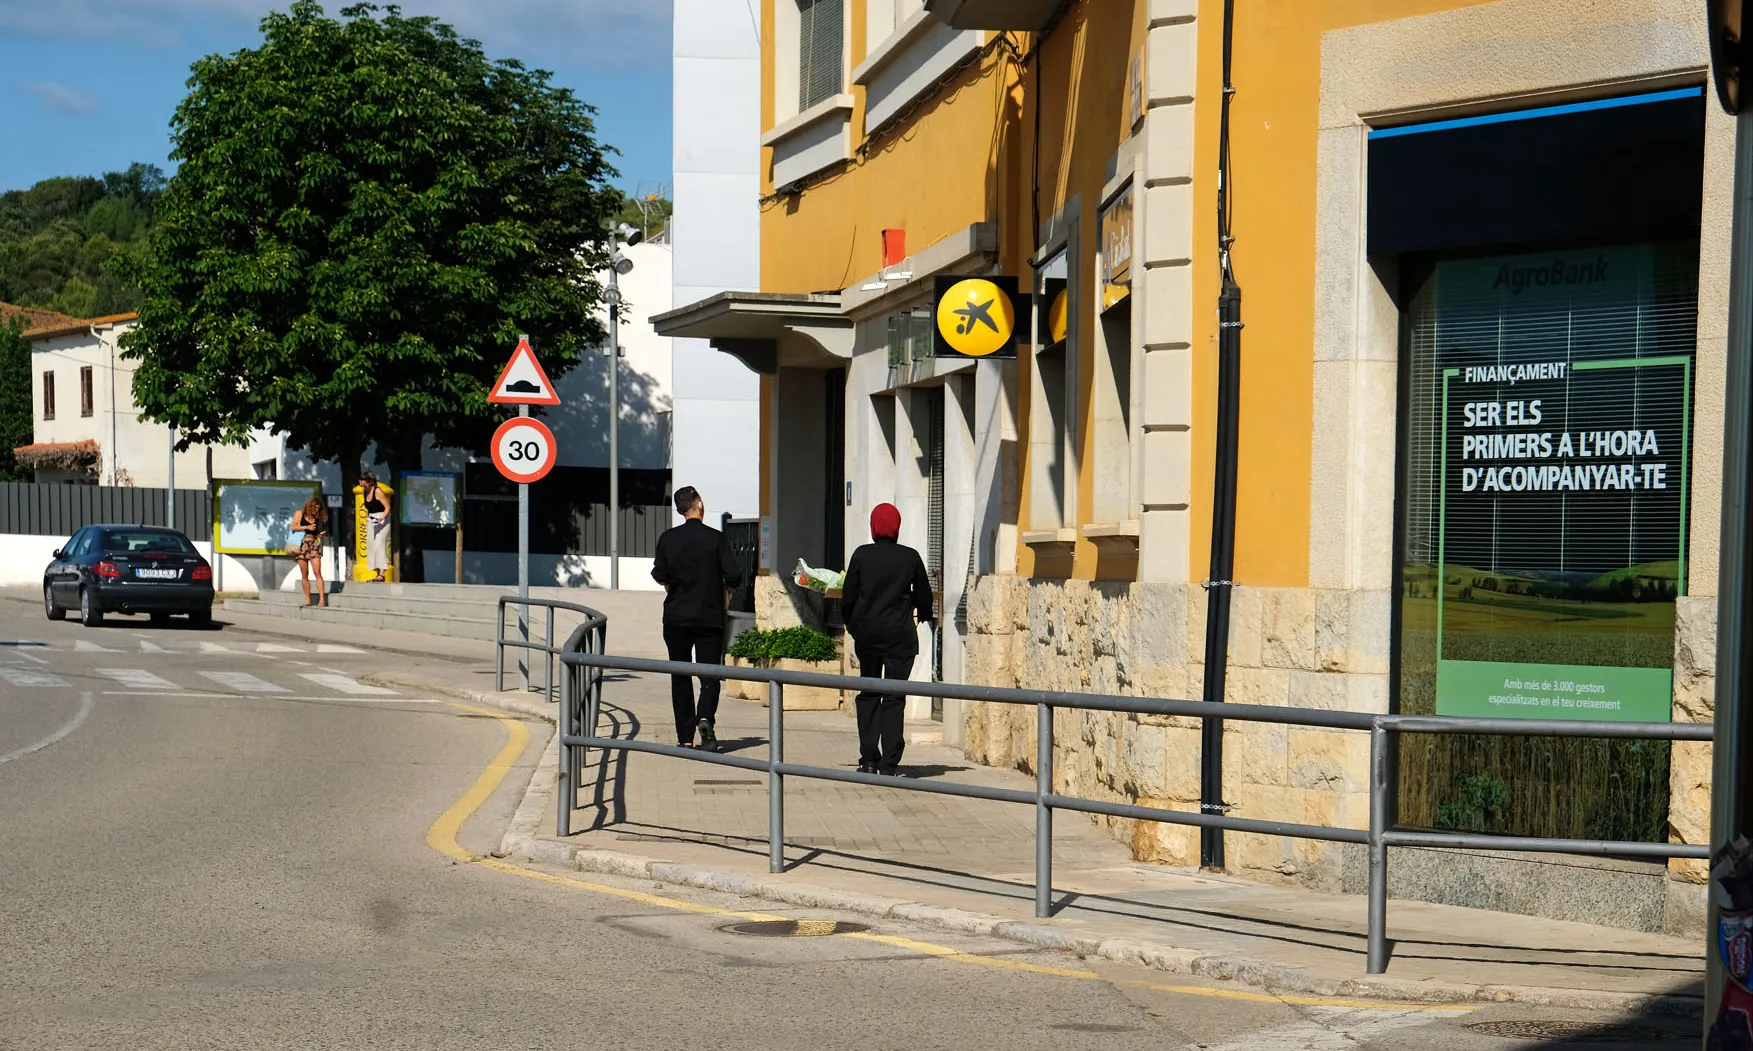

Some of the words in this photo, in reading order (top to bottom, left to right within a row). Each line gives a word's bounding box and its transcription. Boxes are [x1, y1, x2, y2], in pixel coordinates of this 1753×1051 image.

[1494, 253, 1608, 295] AgroBank
[1465, 362, 1566, 385] FINANÇAMENT
[1463, 401, 1501, 427] SER
[1506, 400, 1542, 426] ELS
[509, 440, 539, 461] 30
[1463, 432, 1552, 460] PRIMERS
[1557, 432, 1574, 458] A
[1580, 429, 1659, 457] L'HORA
[1462, 463, 1667, 492] D'ACOMPANYAR-TE
[1504, 678, 1522, 689] Amb
[1541, 680, 1552, 692] de
[1553, 680, 1574, 692] 3.000
[1576, 683, 1605, 695] gestors
[1489, 693, 1539, 707] especialitzats
[1540, 697, 1551, 706] en
[1552, 695, 1560, 707] el
[1561, 697, 1575, 708] teu
[1576, 698, 1621, 710] creixement
